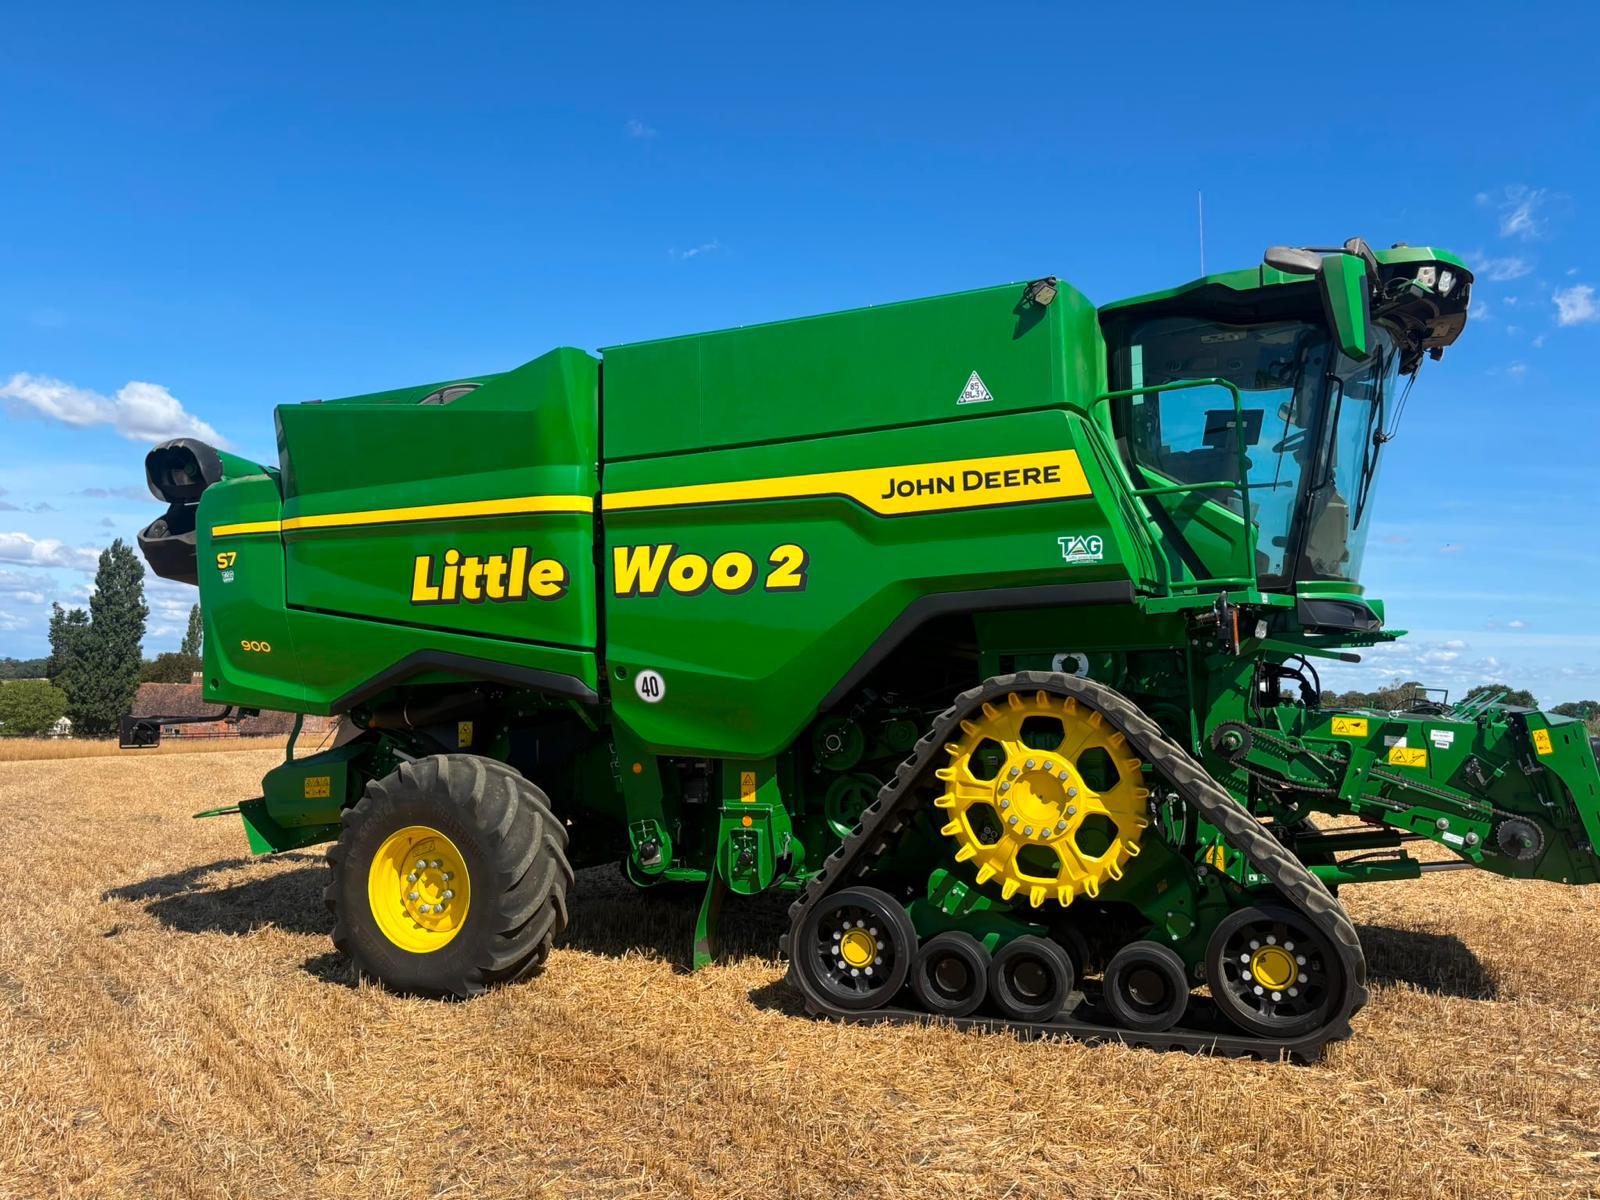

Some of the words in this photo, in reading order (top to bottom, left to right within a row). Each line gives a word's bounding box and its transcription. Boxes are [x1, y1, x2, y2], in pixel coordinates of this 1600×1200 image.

[881, 475, 955, 499] JOHN
[962, 465, 1061, 492] DEERE
[1058, 535, 1103, 556] TAG
[216, 551, 237, 569] S7
[411, 547, 567, 603] Little
[613, 544, 755, 595] Woo
[765, 544, 806, 590] 2
[241, 640, 271, 653] 900
[641, 675, 660, 697] 40
